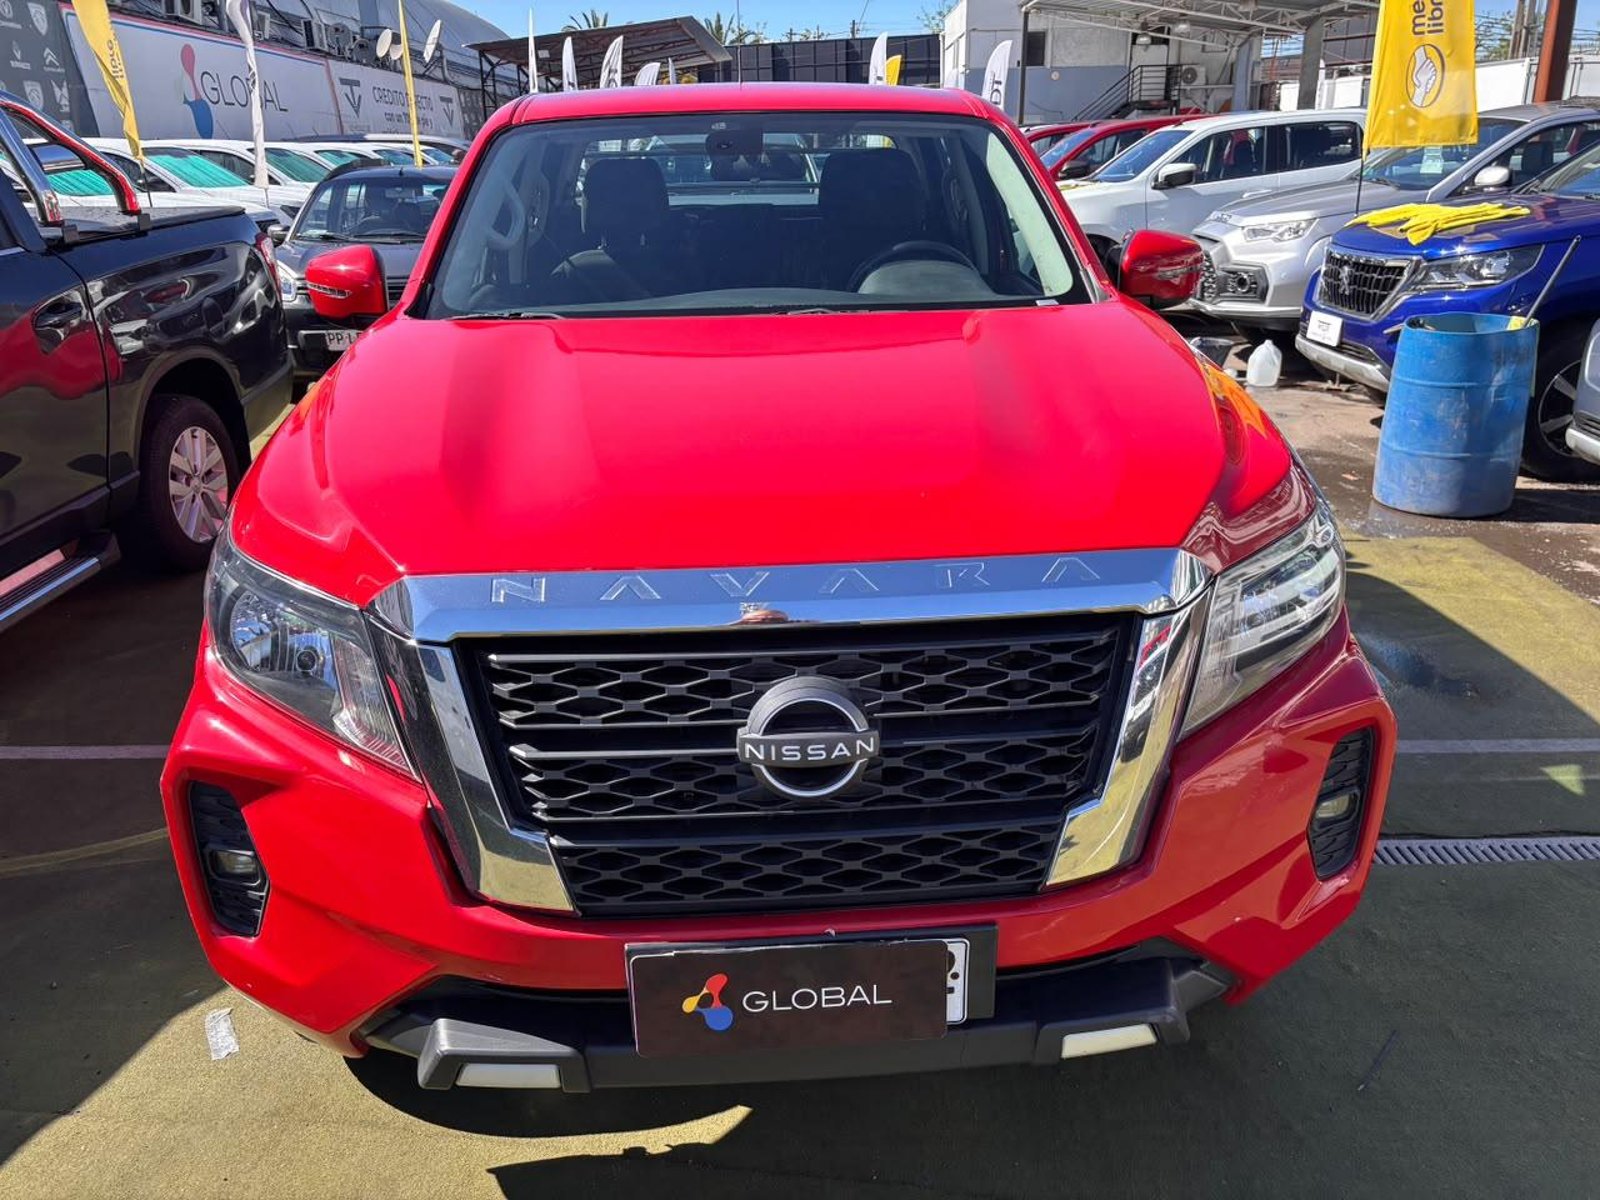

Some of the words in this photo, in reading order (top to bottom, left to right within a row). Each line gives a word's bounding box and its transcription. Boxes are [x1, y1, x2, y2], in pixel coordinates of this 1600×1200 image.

[491, 557, 1101, 603] NAVARA
[744, 736, 875, 762] NISSAN
[742, 984, 893, 1013] GLOBAL
